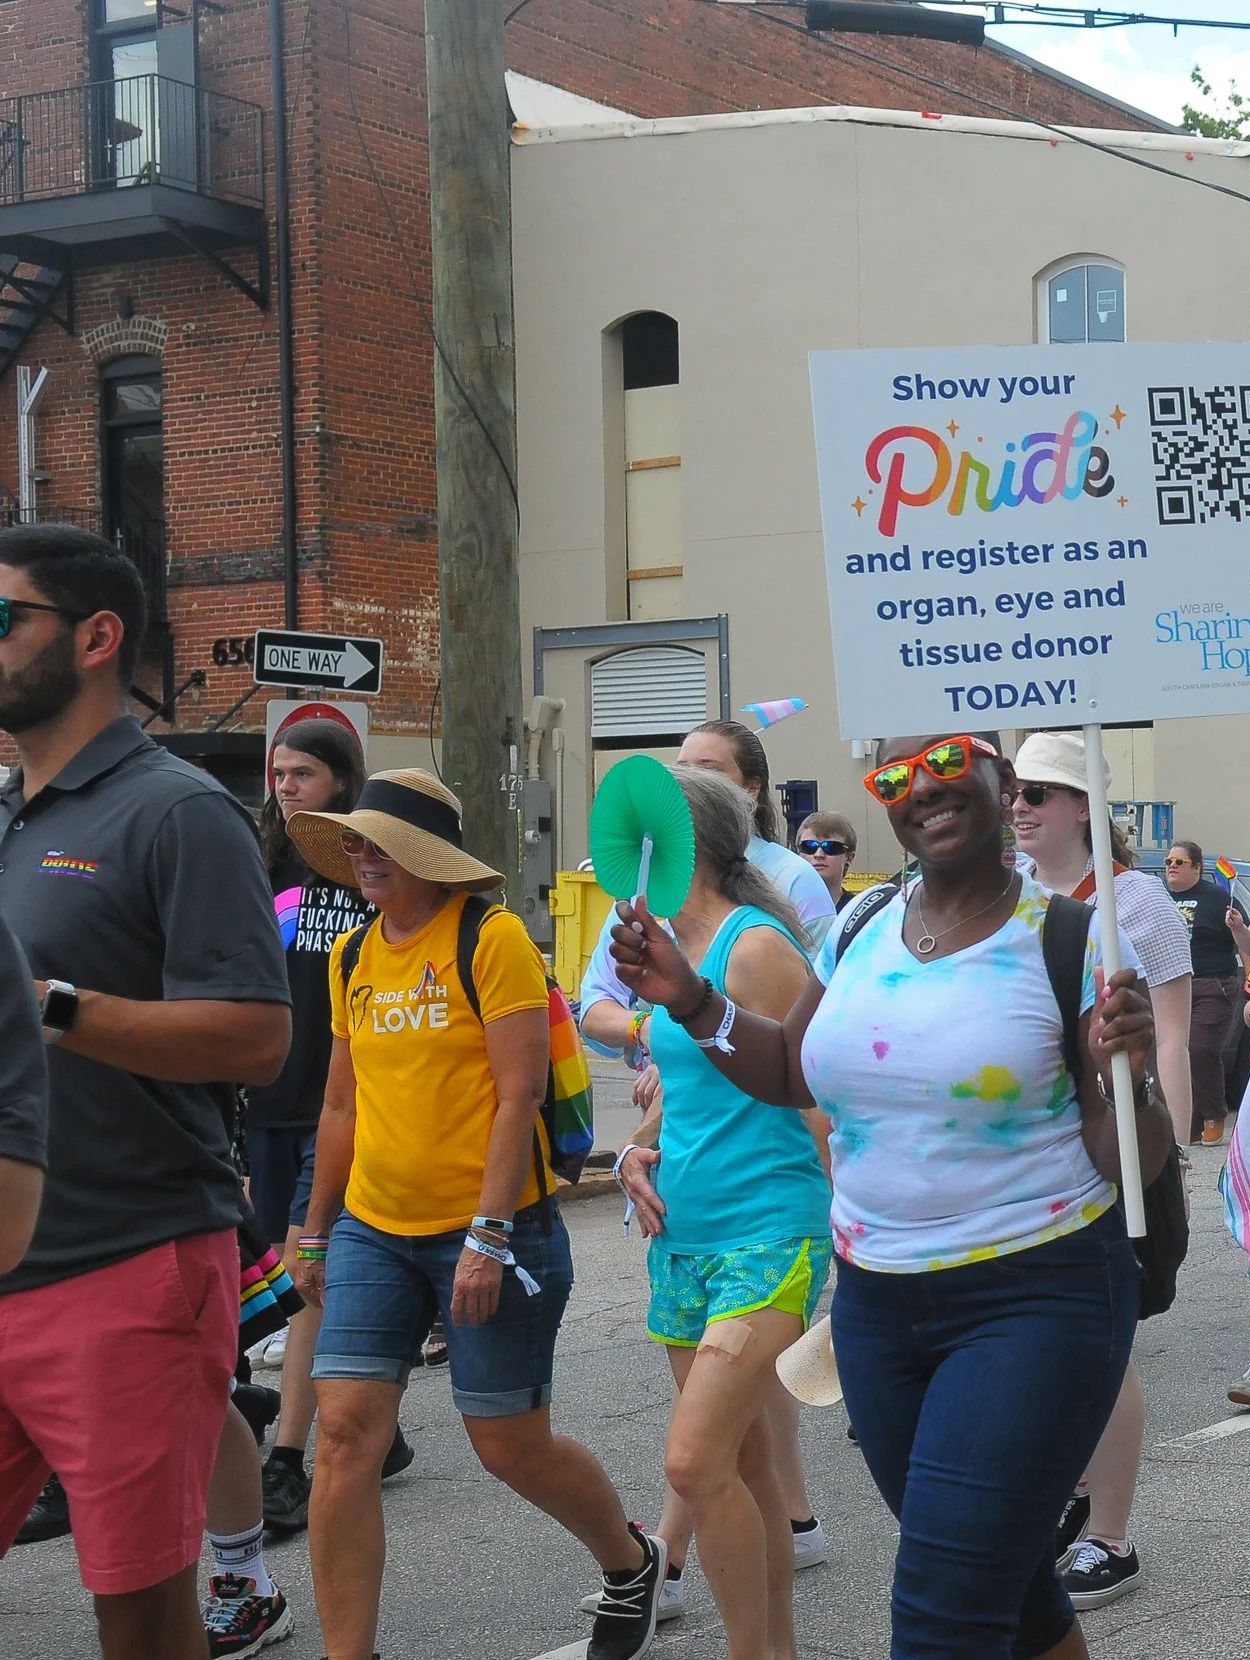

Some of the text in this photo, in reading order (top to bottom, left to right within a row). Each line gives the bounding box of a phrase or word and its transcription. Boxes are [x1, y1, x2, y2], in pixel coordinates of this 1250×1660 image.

[892, 374, 1076, 404] Show your
[865, 410, 1116, 538] Pride
[845, 538, 1148, 575] and register as an
[876, 580, 1126, 625] organ, eye and
[1180, 602, 1224, 615] we are
[268, 648, 342, 673] ONE WAY
[899, 633, 1113, 668] tissue donor
[944, 678, 1077, 713] TODAY!
[1183, 682, 1211, 691] CAROLINA
[1212, 681, 1231, 689] ORGAN
[499, 774, 523, 791] 175
[298, 907, 366, 933] FUCKING
[844, 892, 885, 933] OGIO
[296, 930, 341, 953] PHAS
[373, 990, 405, 1004] SIDE
[372, 1002, 449, 1034] LOVE
